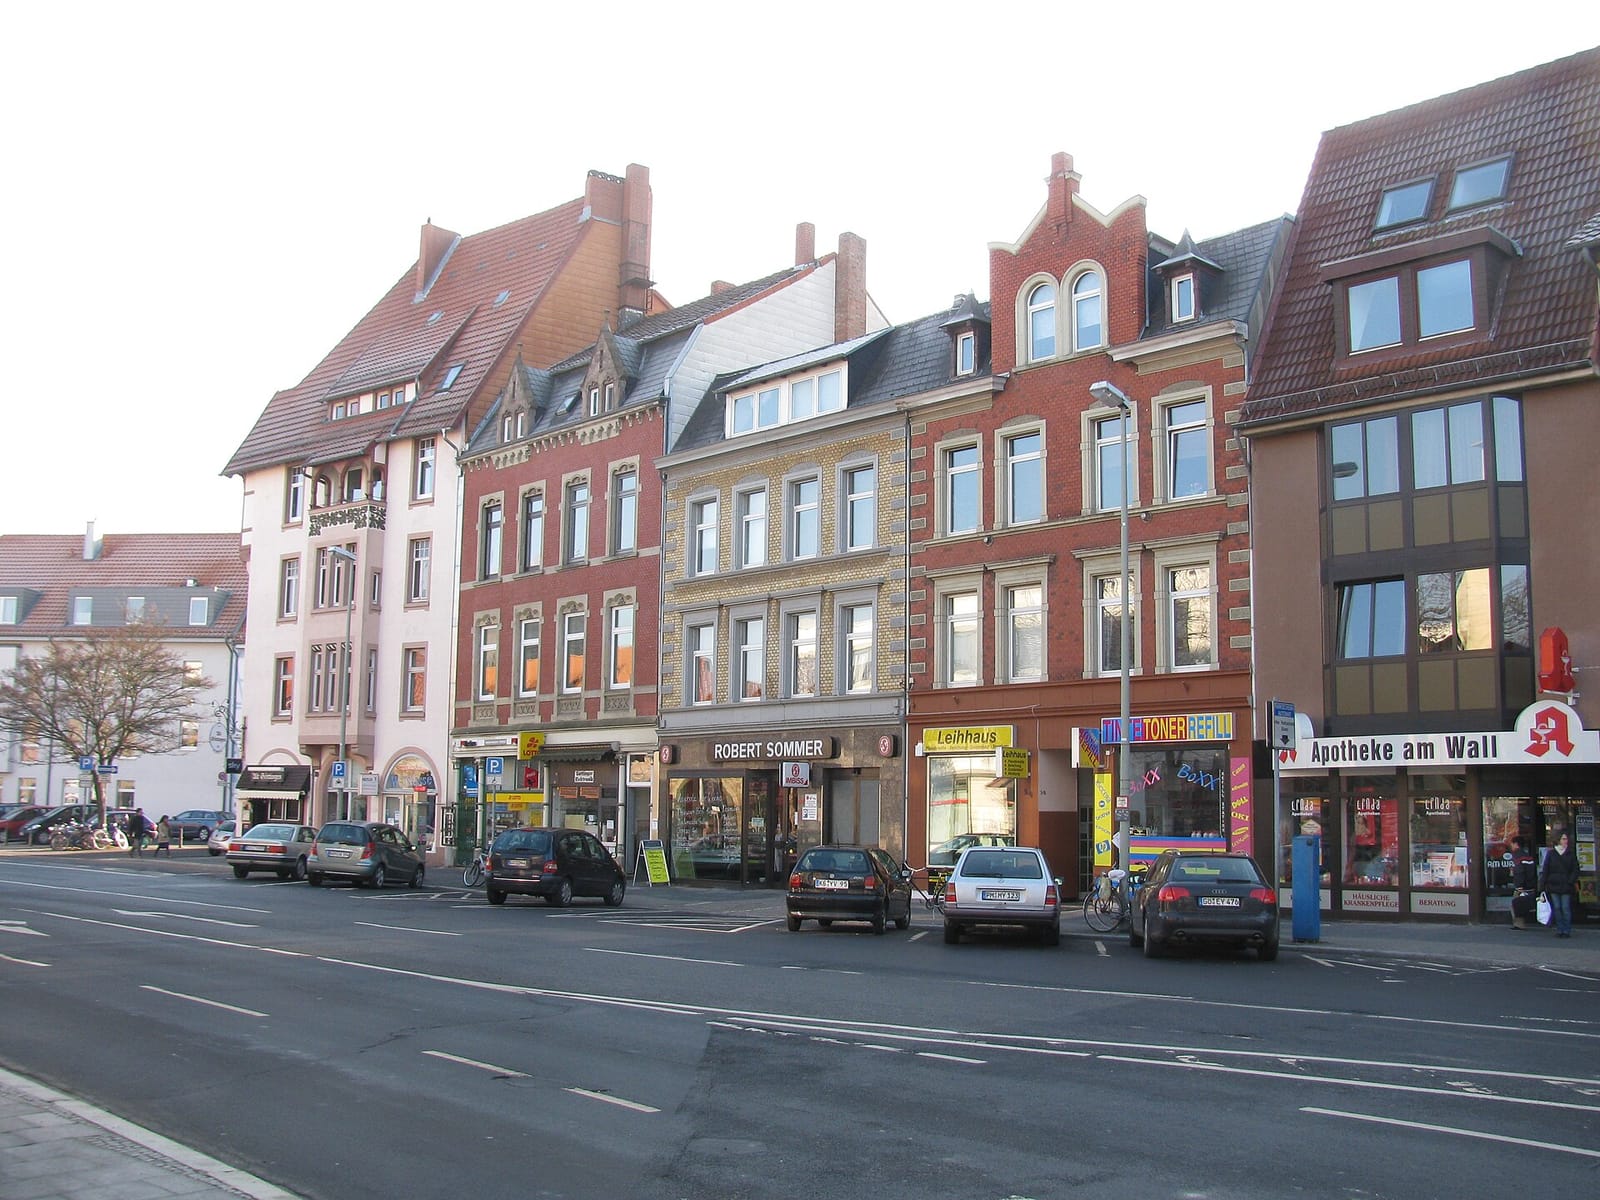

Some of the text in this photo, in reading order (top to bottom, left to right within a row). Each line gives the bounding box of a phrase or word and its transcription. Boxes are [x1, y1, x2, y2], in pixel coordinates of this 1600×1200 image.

[1103, 717, 1142, 742] TINE
[1143, 716, 1186, 741] TONER
[1188, 713, 1232, 740] REFILL
[938, 729, 997, 745] Leihhaus
[714, 740, 823, 759] ROBERT SOMMER
[1002, 750, 1027, 758] Leihhaus
[1311, 735, 1498, 766] Apotheke am Wall
[785, 777, 804, 785] IMBISS
[1177, 763, 1220, 791] BoXX
[1231, 811, 1249, 822] OKI
[1352, 893, 1390, 901] HÄUSLICHE
[1344, 899, 1399, 909] KRANKENPFLEGE
[1419, 899, 1456, 907] BERATUNG
